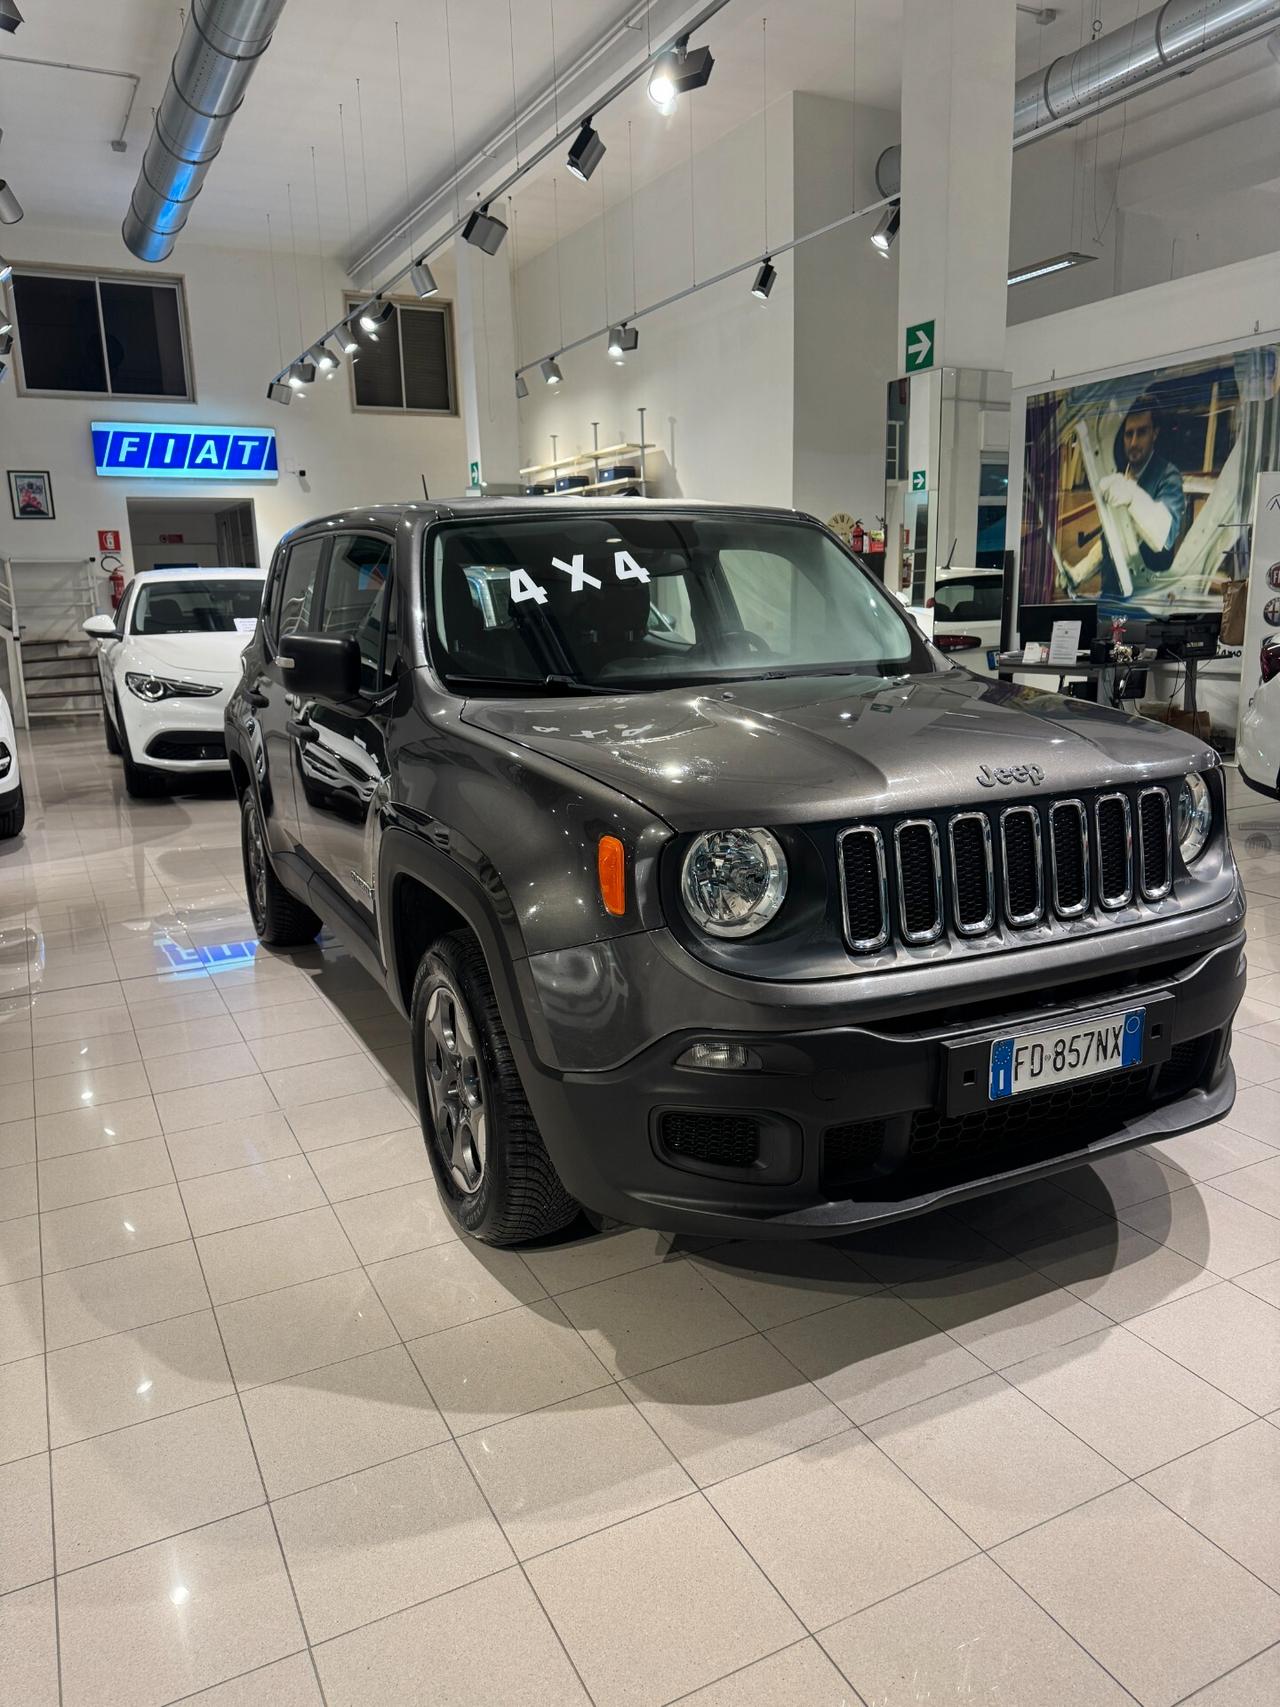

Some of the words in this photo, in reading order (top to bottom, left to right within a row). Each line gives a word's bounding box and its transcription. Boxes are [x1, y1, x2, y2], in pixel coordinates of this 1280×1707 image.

[118, 437, 259, 465] FIAT
[977, 762, 1046, 788] Jeep
[1052, 1024, 1124, 1073] 857NX
